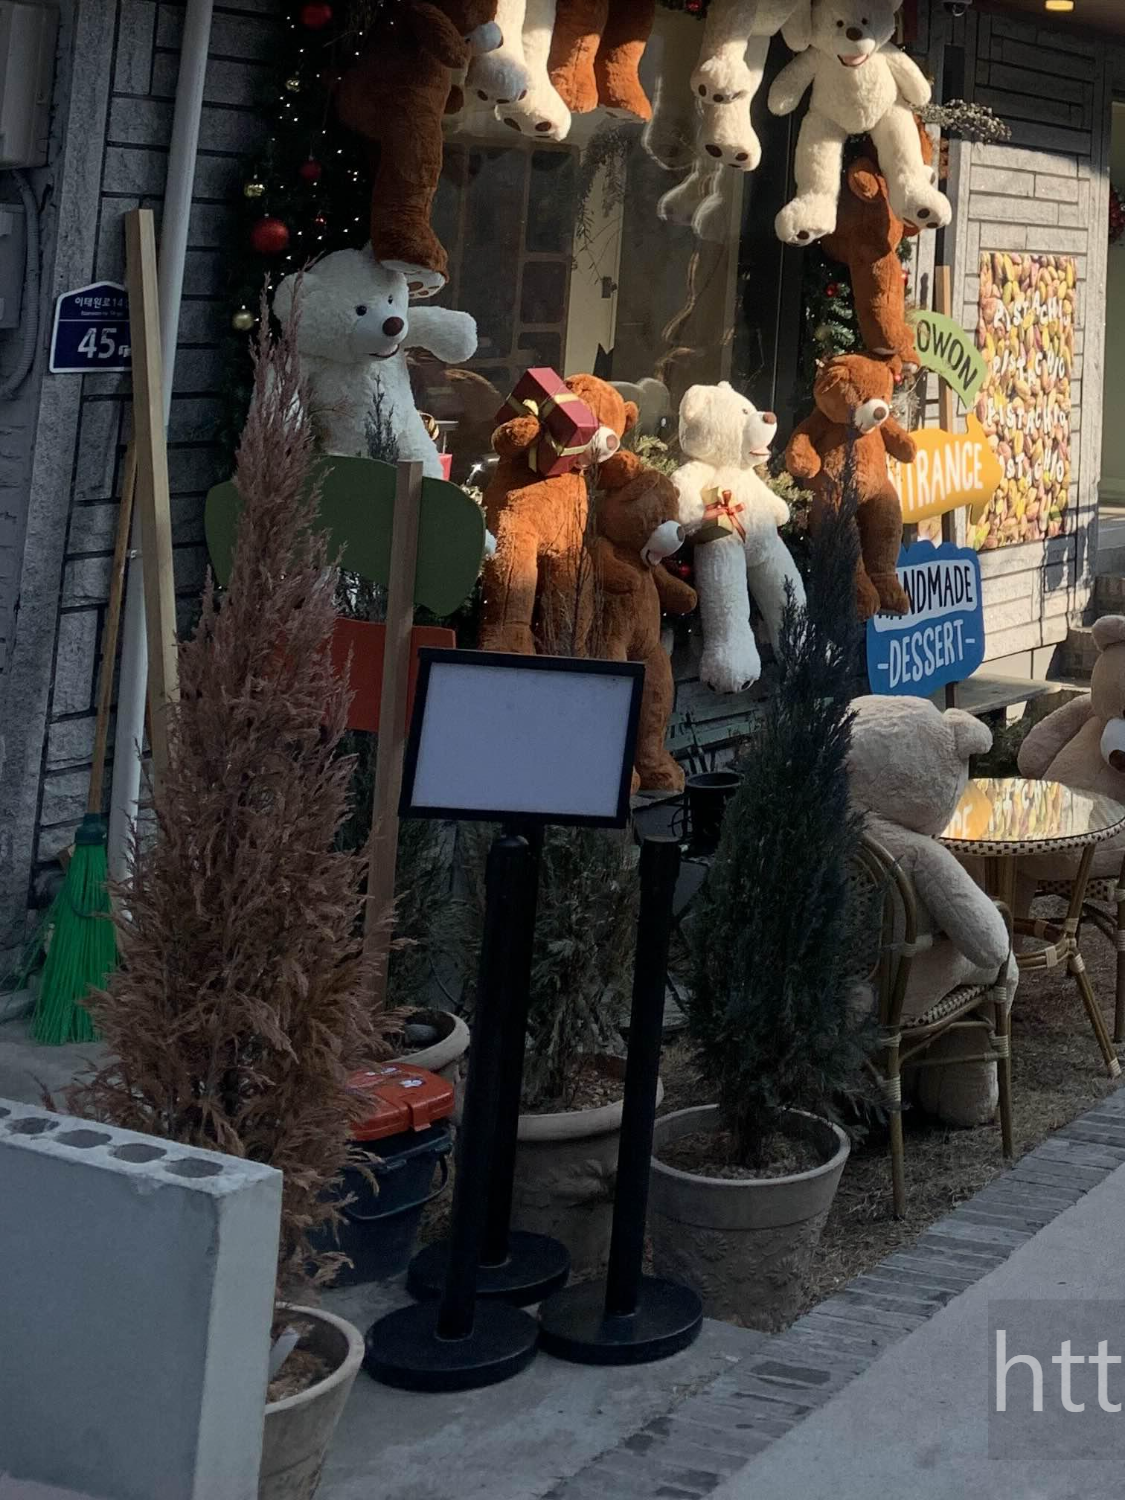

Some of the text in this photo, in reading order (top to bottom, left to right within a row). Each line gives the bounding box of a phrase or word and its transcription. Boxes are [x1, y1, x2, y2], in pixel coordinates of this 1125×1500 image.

[75, 297, 129, 309] 이태원로14
[992, 346, 1067, 389] PISTACHIO
[987, 396, 1067, 435] PISTACHIO
[878, 565, 973, 620] NDMADE
